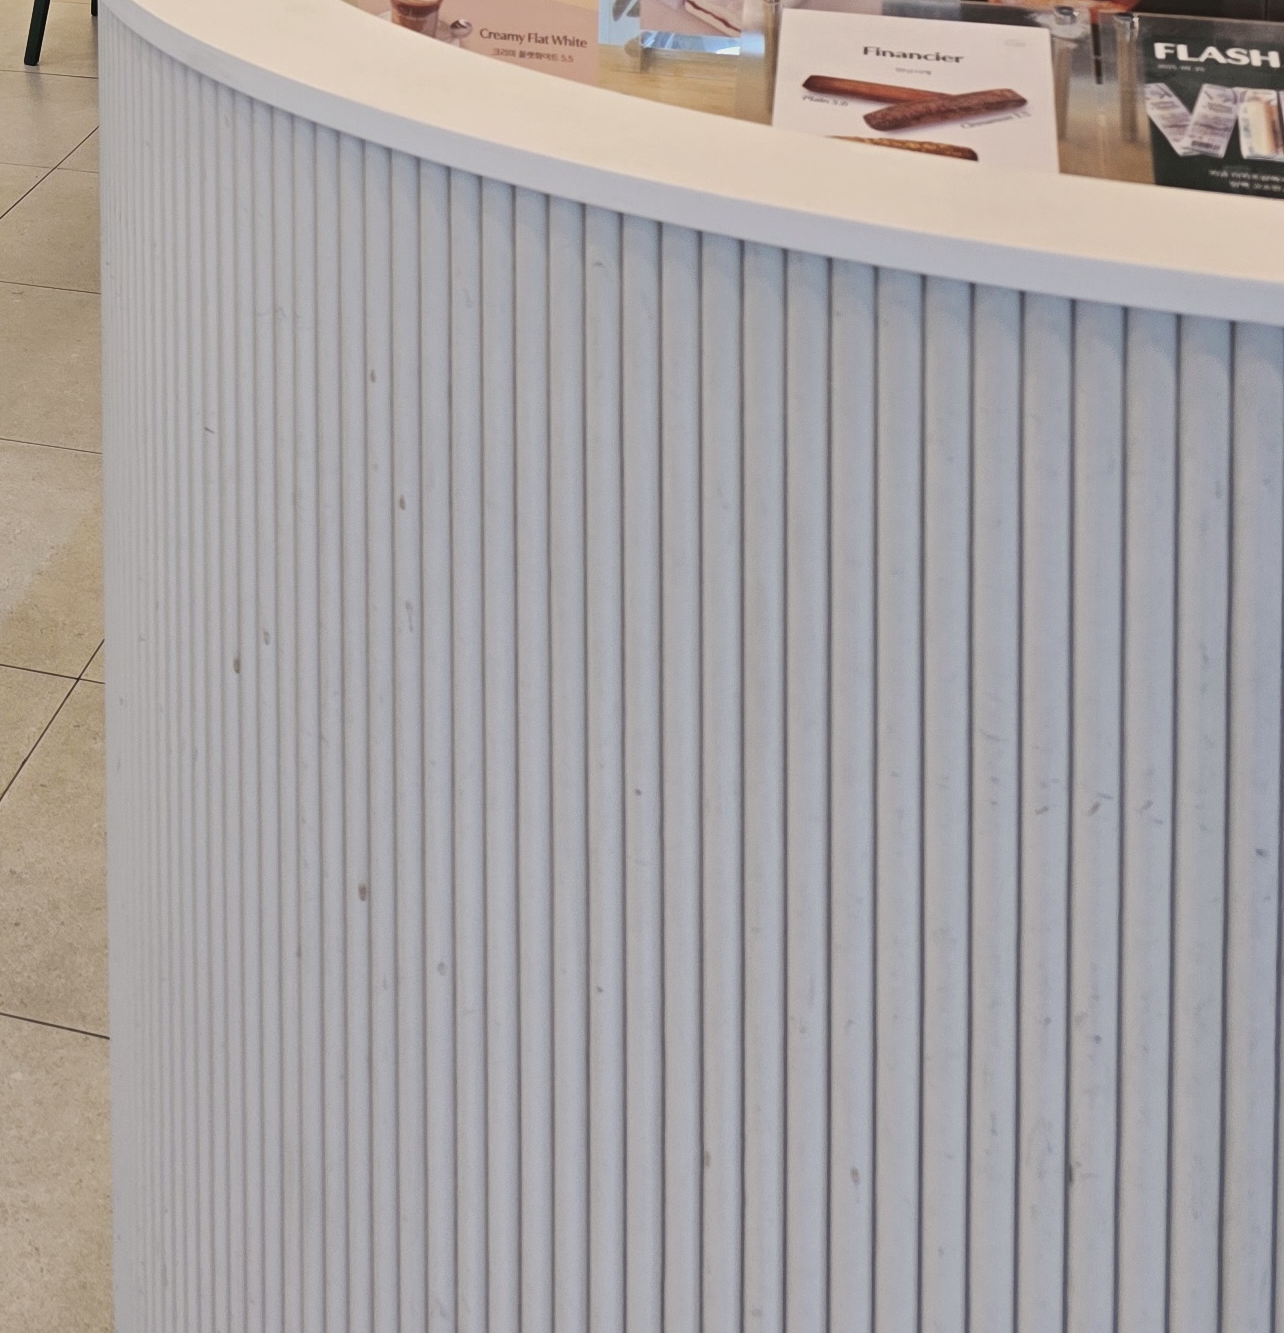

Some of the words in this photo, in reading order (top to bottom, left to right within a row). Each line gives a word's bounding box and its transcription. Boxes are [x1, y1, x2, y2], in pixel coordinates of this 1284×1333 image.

[479, 28, 525, 45] Creamy
[528, 32, 550, 45] Flat
[552, 35, 588, 48] White
[862, 46, 965, 64] Financier
[1154, 42, 1281, 69] FLASH
